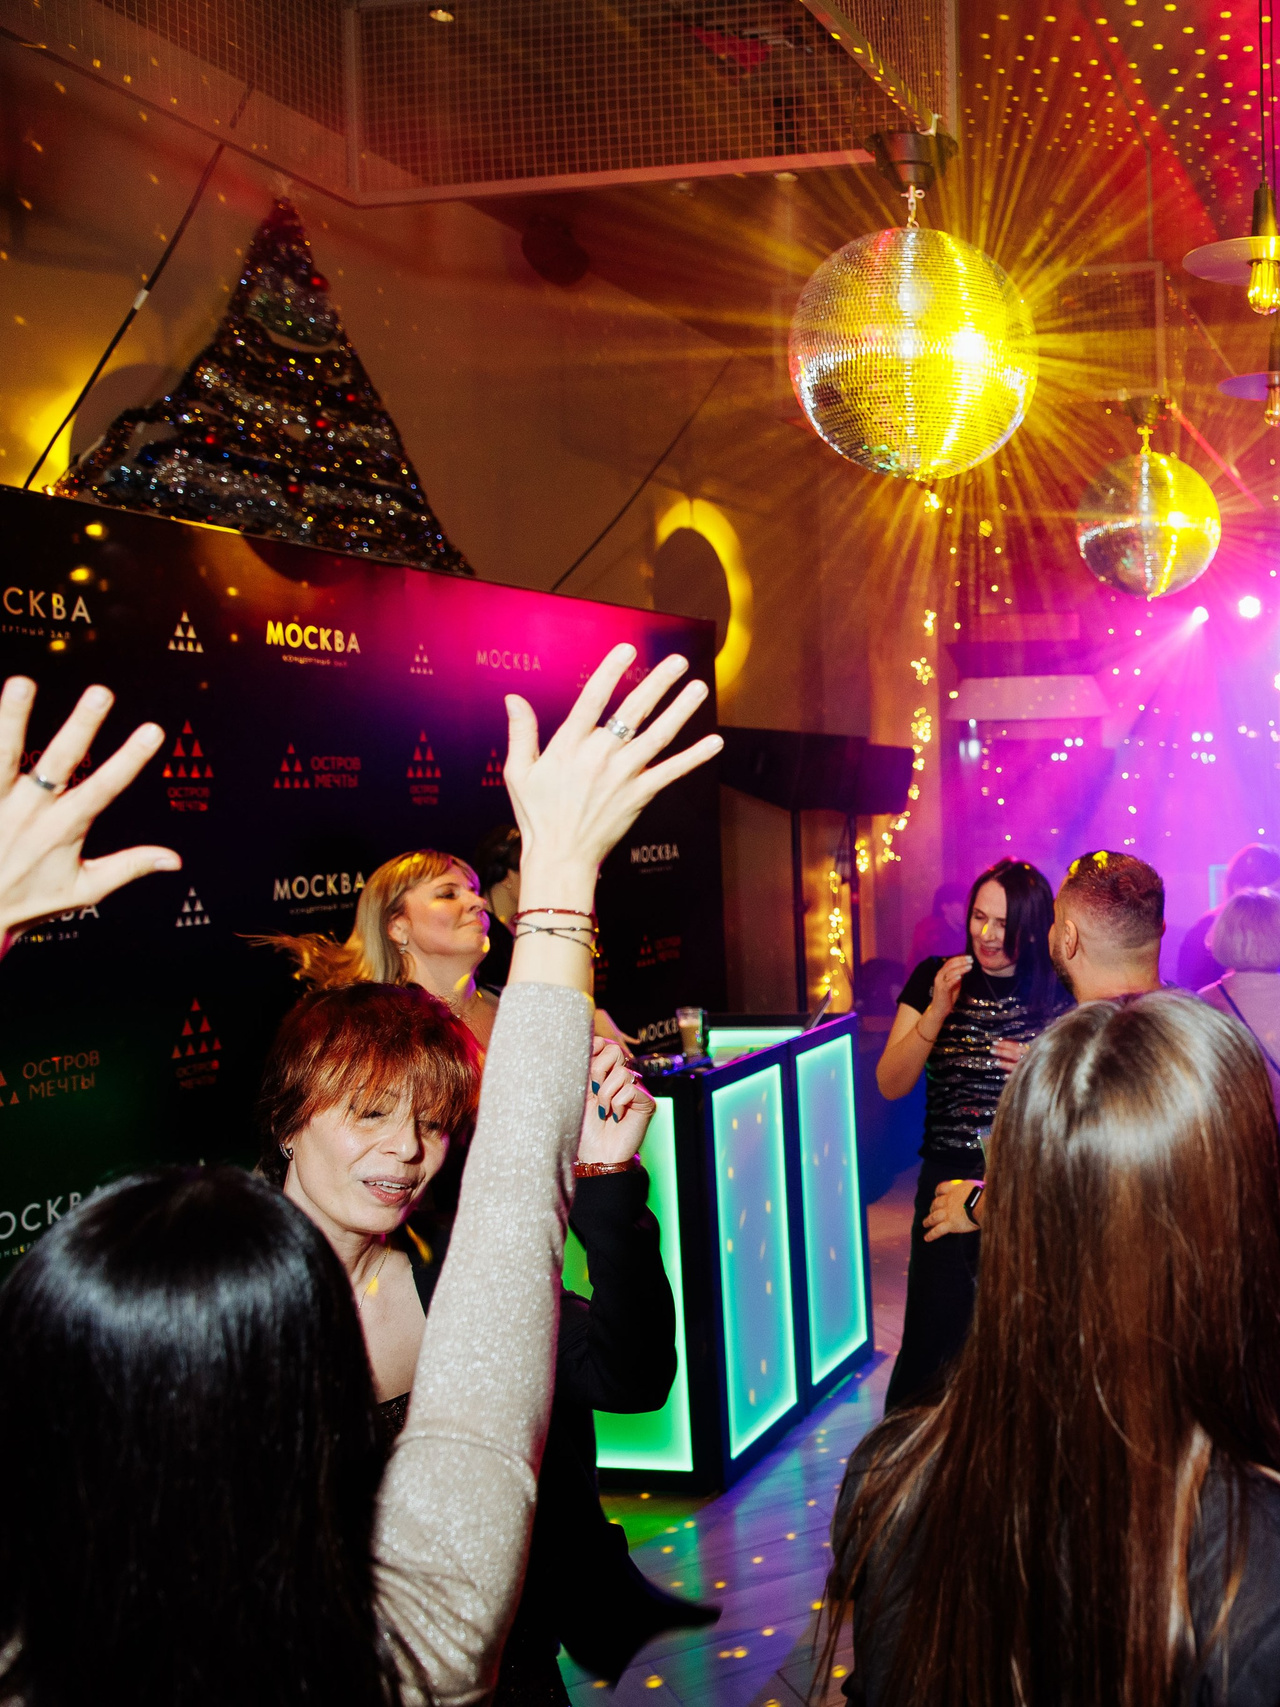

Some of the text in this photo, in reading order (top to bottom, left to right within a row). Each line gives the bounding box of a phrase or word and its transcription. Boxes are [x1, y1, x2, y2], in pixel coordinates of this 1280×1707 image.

[265, 619, 361, 654] МОСКВА
[475, 649, 542, 671] МОСКВА
[311, 756, 361, 771] ОСТРОВ
[630, 843, 680, 864] МОСКВА
[272, 871, 367, 902] МОСКВА
[22, 1050, 101, 1080] ОСТРОВ
[28, 1072, 96, 1101] МЕЧТЫ
